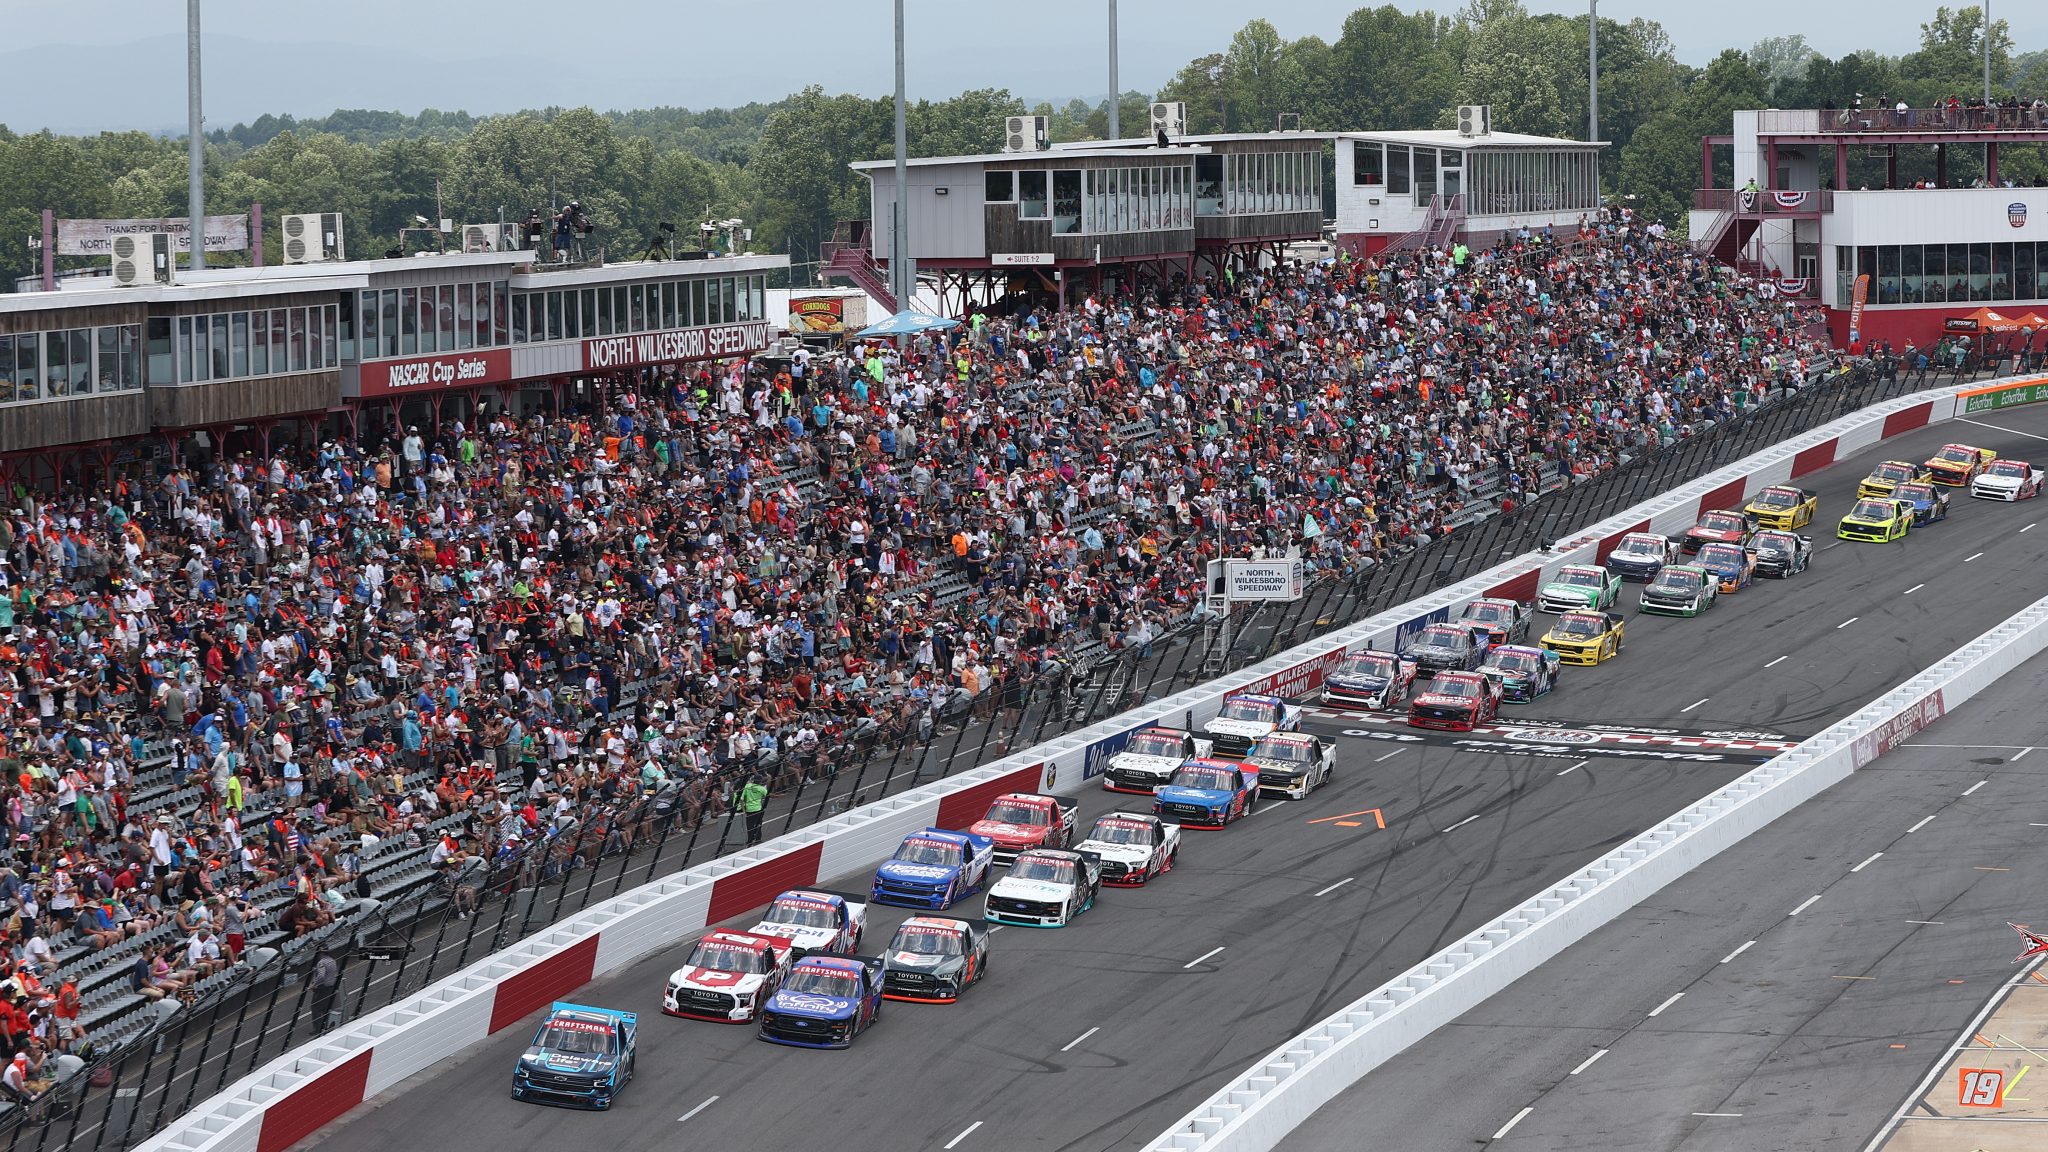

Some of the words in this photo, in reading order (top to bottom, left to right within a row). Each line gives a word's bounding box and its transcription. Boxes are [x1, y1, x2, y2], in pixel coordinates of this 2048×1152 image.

[105, 225, 136, 234] THANKS
[139, 225, 156, 233] FOR
[80, 240, 112, 249] NORTH
[179, 235, 227, 247] SPDWAY
[802, 302, 831, 312] CORNDOGS
[590, 337, 634, 368] NORTH
[636, 329, 705, 363] WILKESBORO
[708, 324, 768, 355] SPEEDWAY
[388, 362, 430, 387] NASCAR
[432, 361, 455, 386] Cup
[457, 357, 487, 380] Series
[2000, 388, 2028, 405] EchoPark
[1968, 394, 1994, 410] EchoPark
[1238, 584, 1283, 592] SPEEDWAY
[1498, 650, 1531, 658] CRAFTSMAN
[1352, 655, 1386, 664] CRAFTSMAN
[1248, 678, 1272, 693] NORTH
[1278, 657, 1325, 685] WILKESBORO
[1439, 676, 1473, 684] CRAFTSMAN
[1264, 675, 1311, 699] PEEDWAY
[1232, 700, 1268, 708] CRAFTSMAN
[1138, 734, 1176, 743] CRAFTSMAN
[1267, 738, 1305, 746] CRAFTSMAN
[1184, 766, 1226, 775] CRAFTSMAN
[1000, 800, 1040, 810] CRAFTSMAN
[1103, 820, 1144, 829] CRAFTSMAN
[911, 839, 952, 849] CRAFTSMAN
[1023, 856, 1065, 866] CRAFTSMAN
[781, 900, 826, 909] CRAFTSMAN
[758, 924, 824, 938] Mobil
[906, 926, 953, 936] CRAFTSMAN
[704, 942, 755, 954] CRAFTSMAN
[800, 966, 848, 977] CRAFTSMAN
[898, 972, 922, 980] TOYOTA
[693, 990, 719, 999] TOYOTA
[554, 1020, 605, 1032] CRAFTSMAN
[551, 1053, 612, 1066] Delaware
[1960, 1072, 2001, 1105] 19
